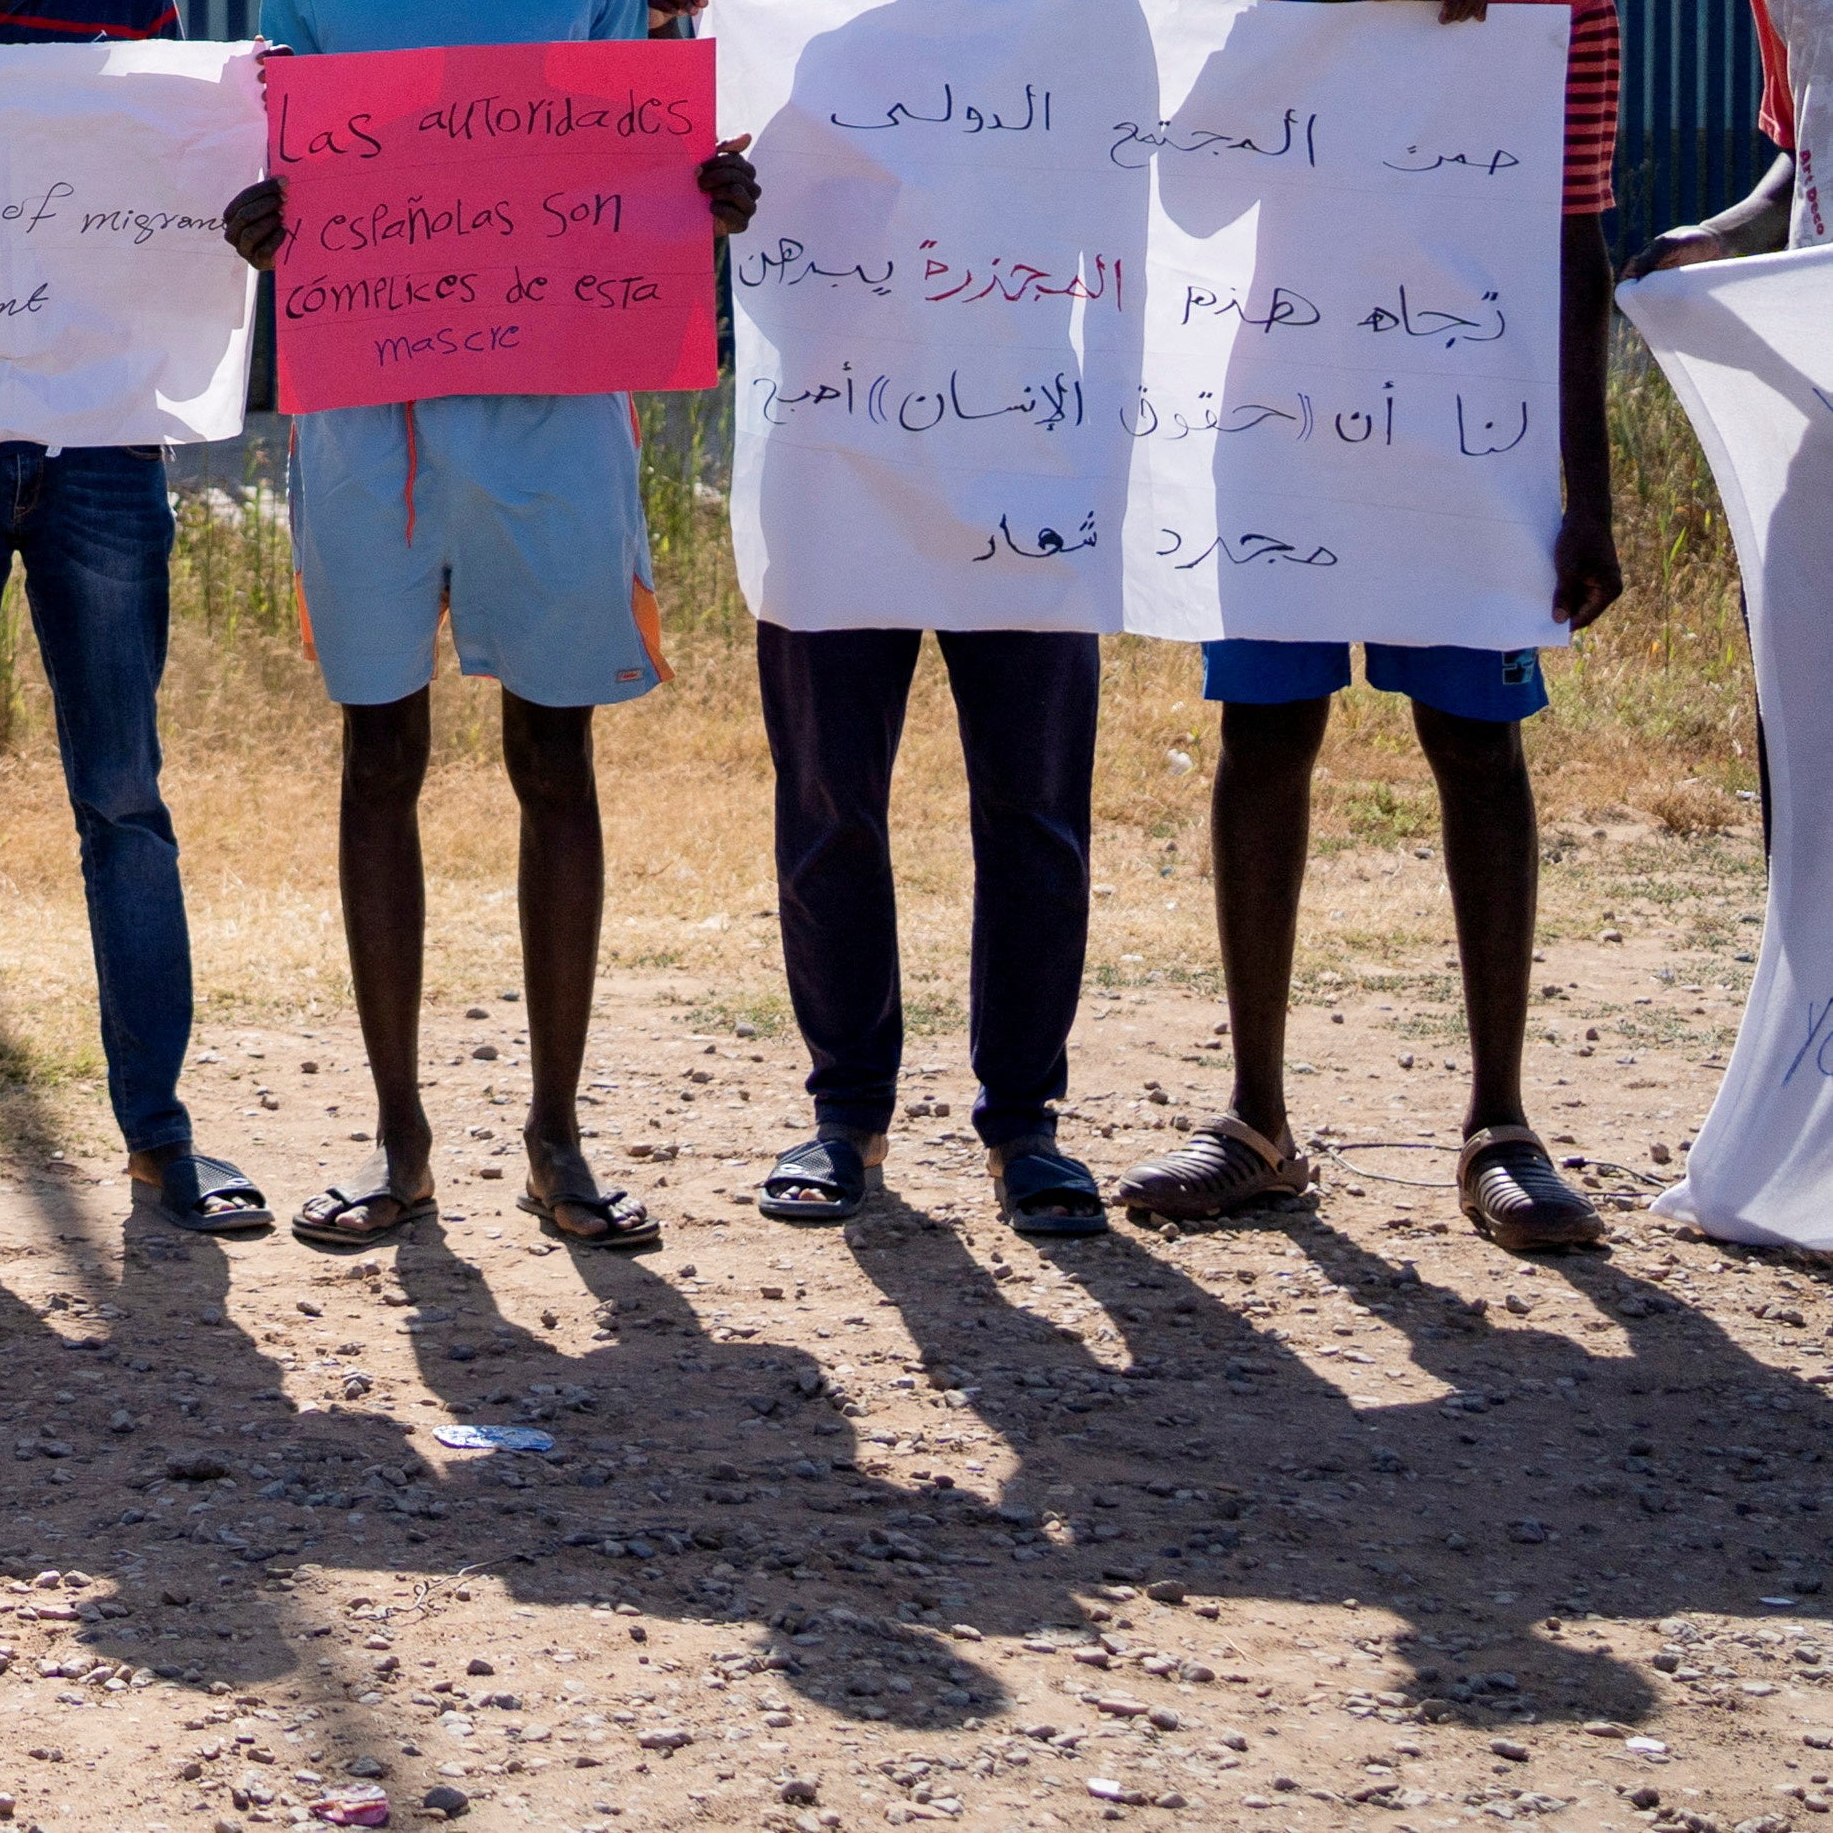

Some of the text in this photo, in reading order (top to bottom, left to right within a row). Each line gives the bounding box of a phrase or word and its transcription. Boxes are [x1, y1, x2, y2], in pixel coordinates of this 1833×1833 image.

[2, 181, 74, 234] of
[282, 216, 303, 265] y
[505, 265, 549, 305] de
[374, 323, 521, 366] mascre
